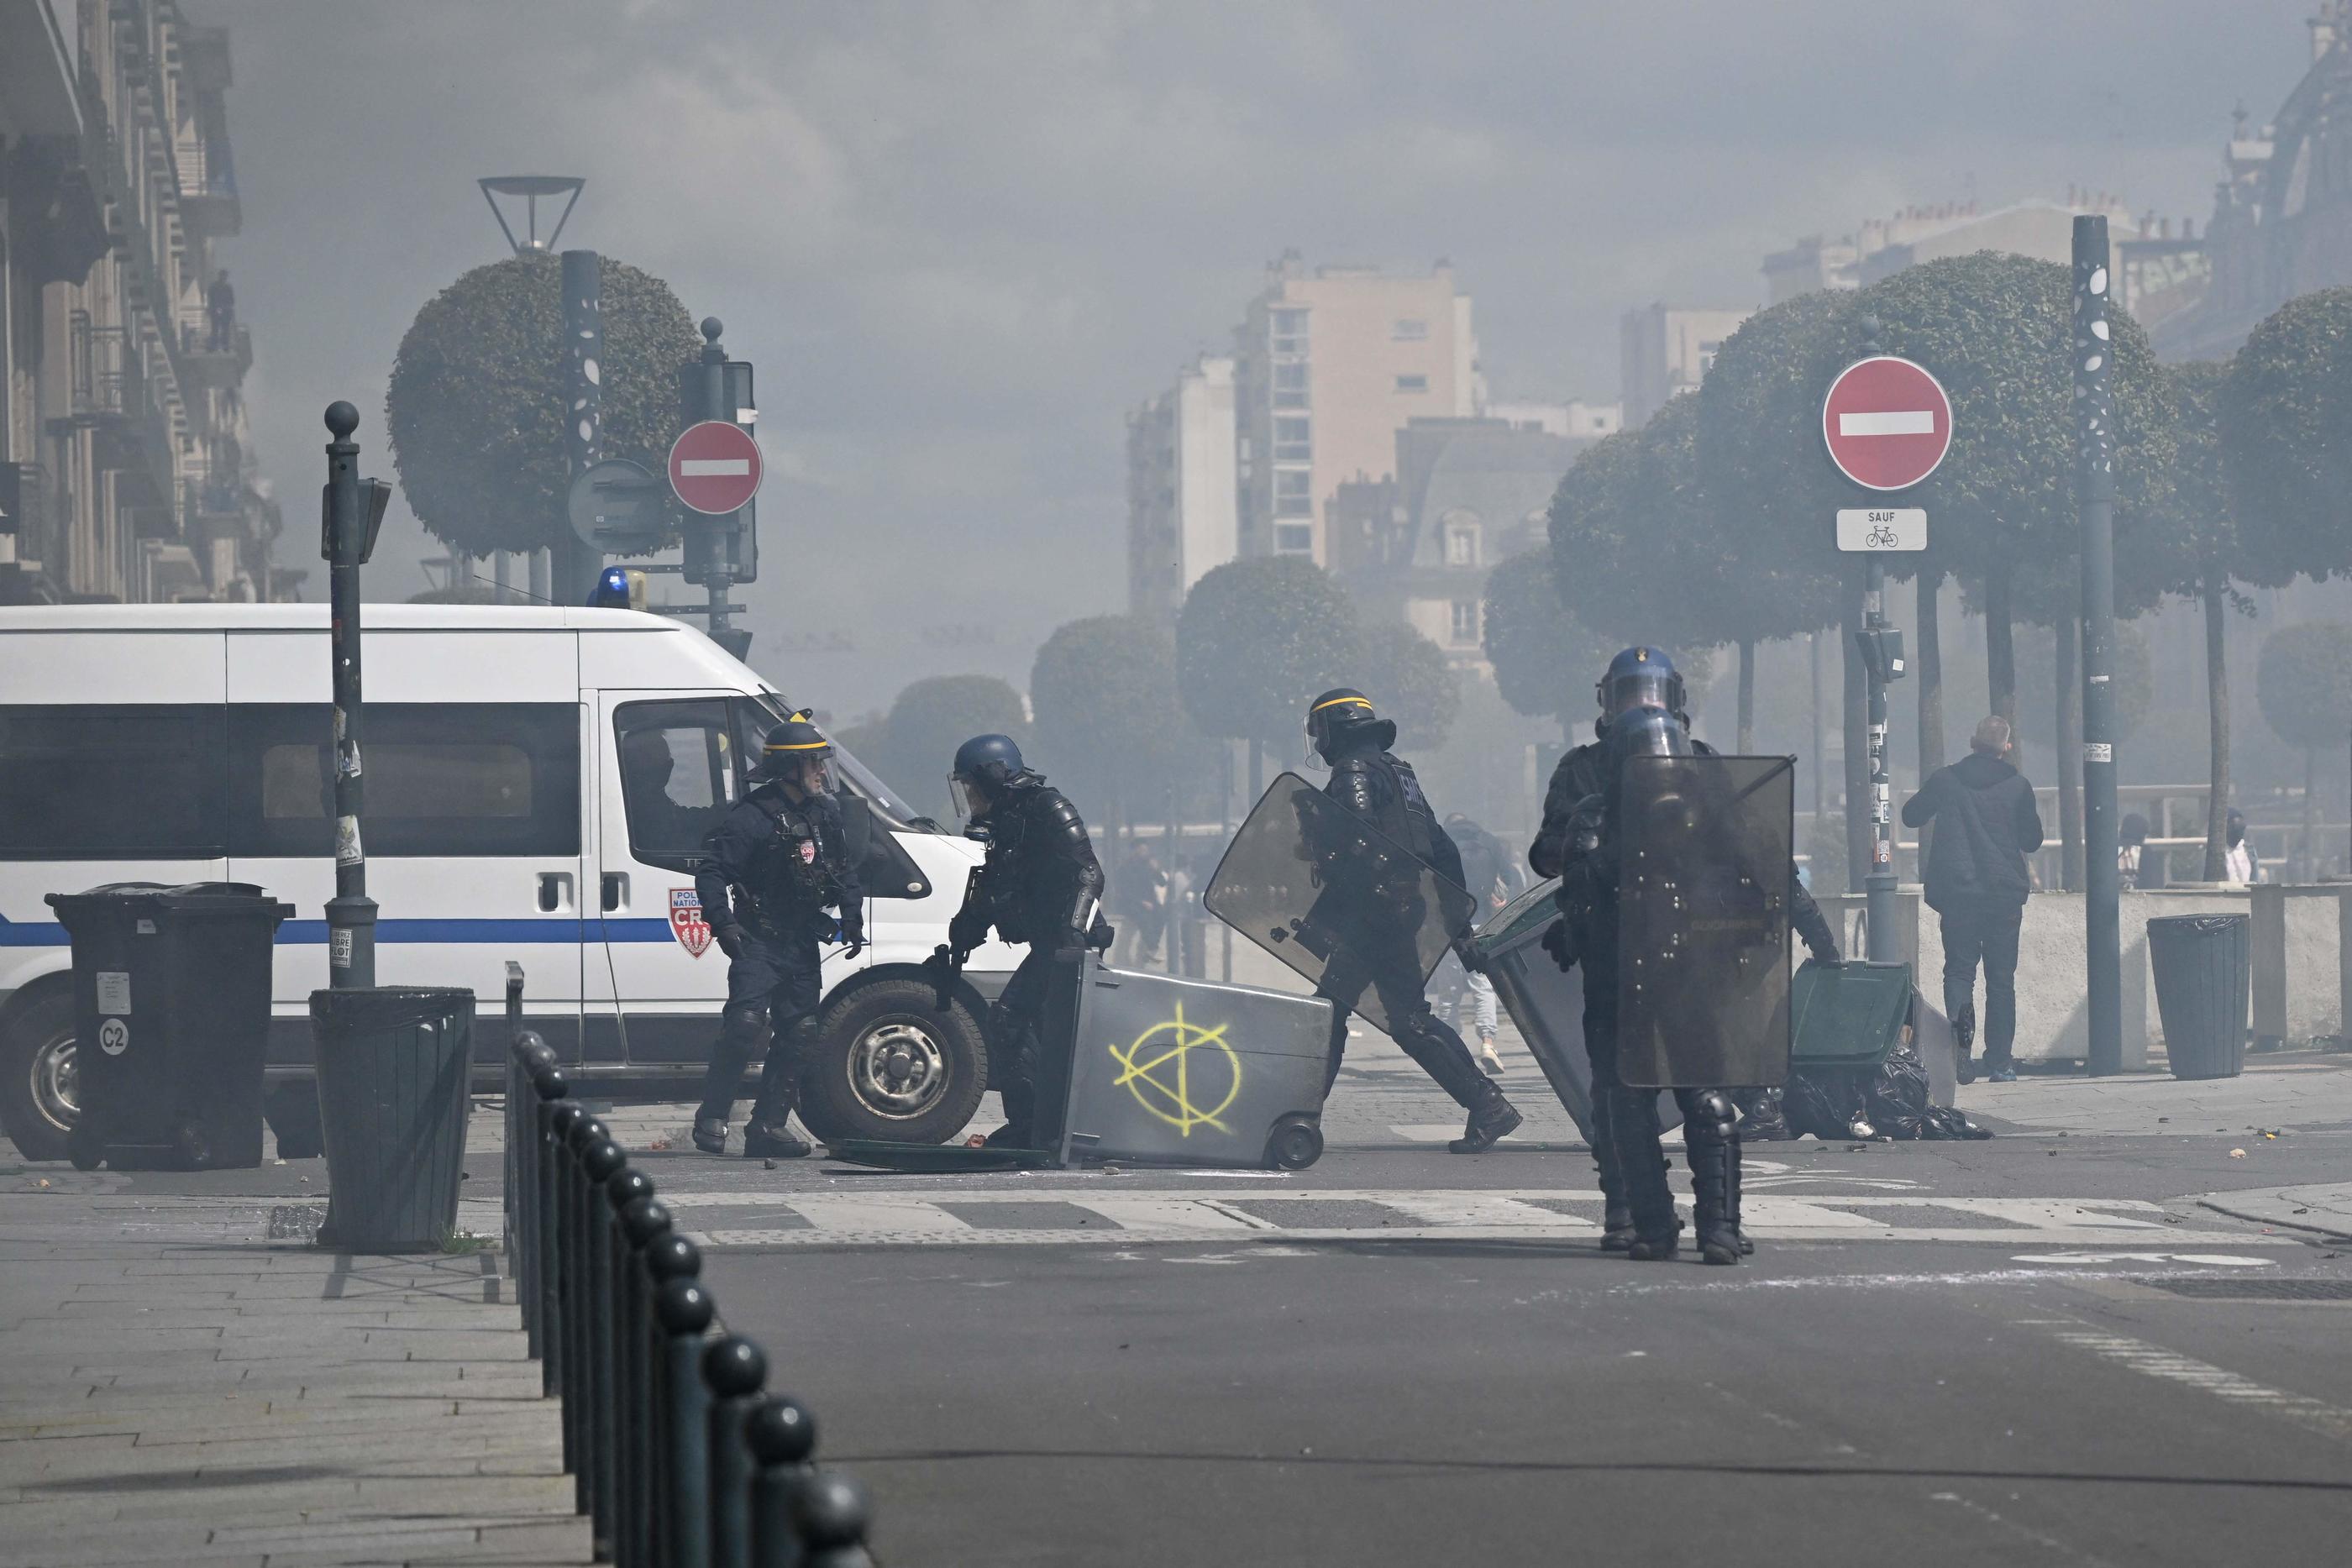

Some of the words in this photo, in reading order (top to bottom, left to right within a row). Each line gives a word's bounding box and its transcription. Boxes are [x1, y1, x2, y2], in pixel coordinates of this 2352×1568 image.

[1868, 511, 1895, 522] SAUF
[673, 899, 704, 907] NATION
[675, 910, 705, 926] CR
[102, 1026, 123, 1047] C2
